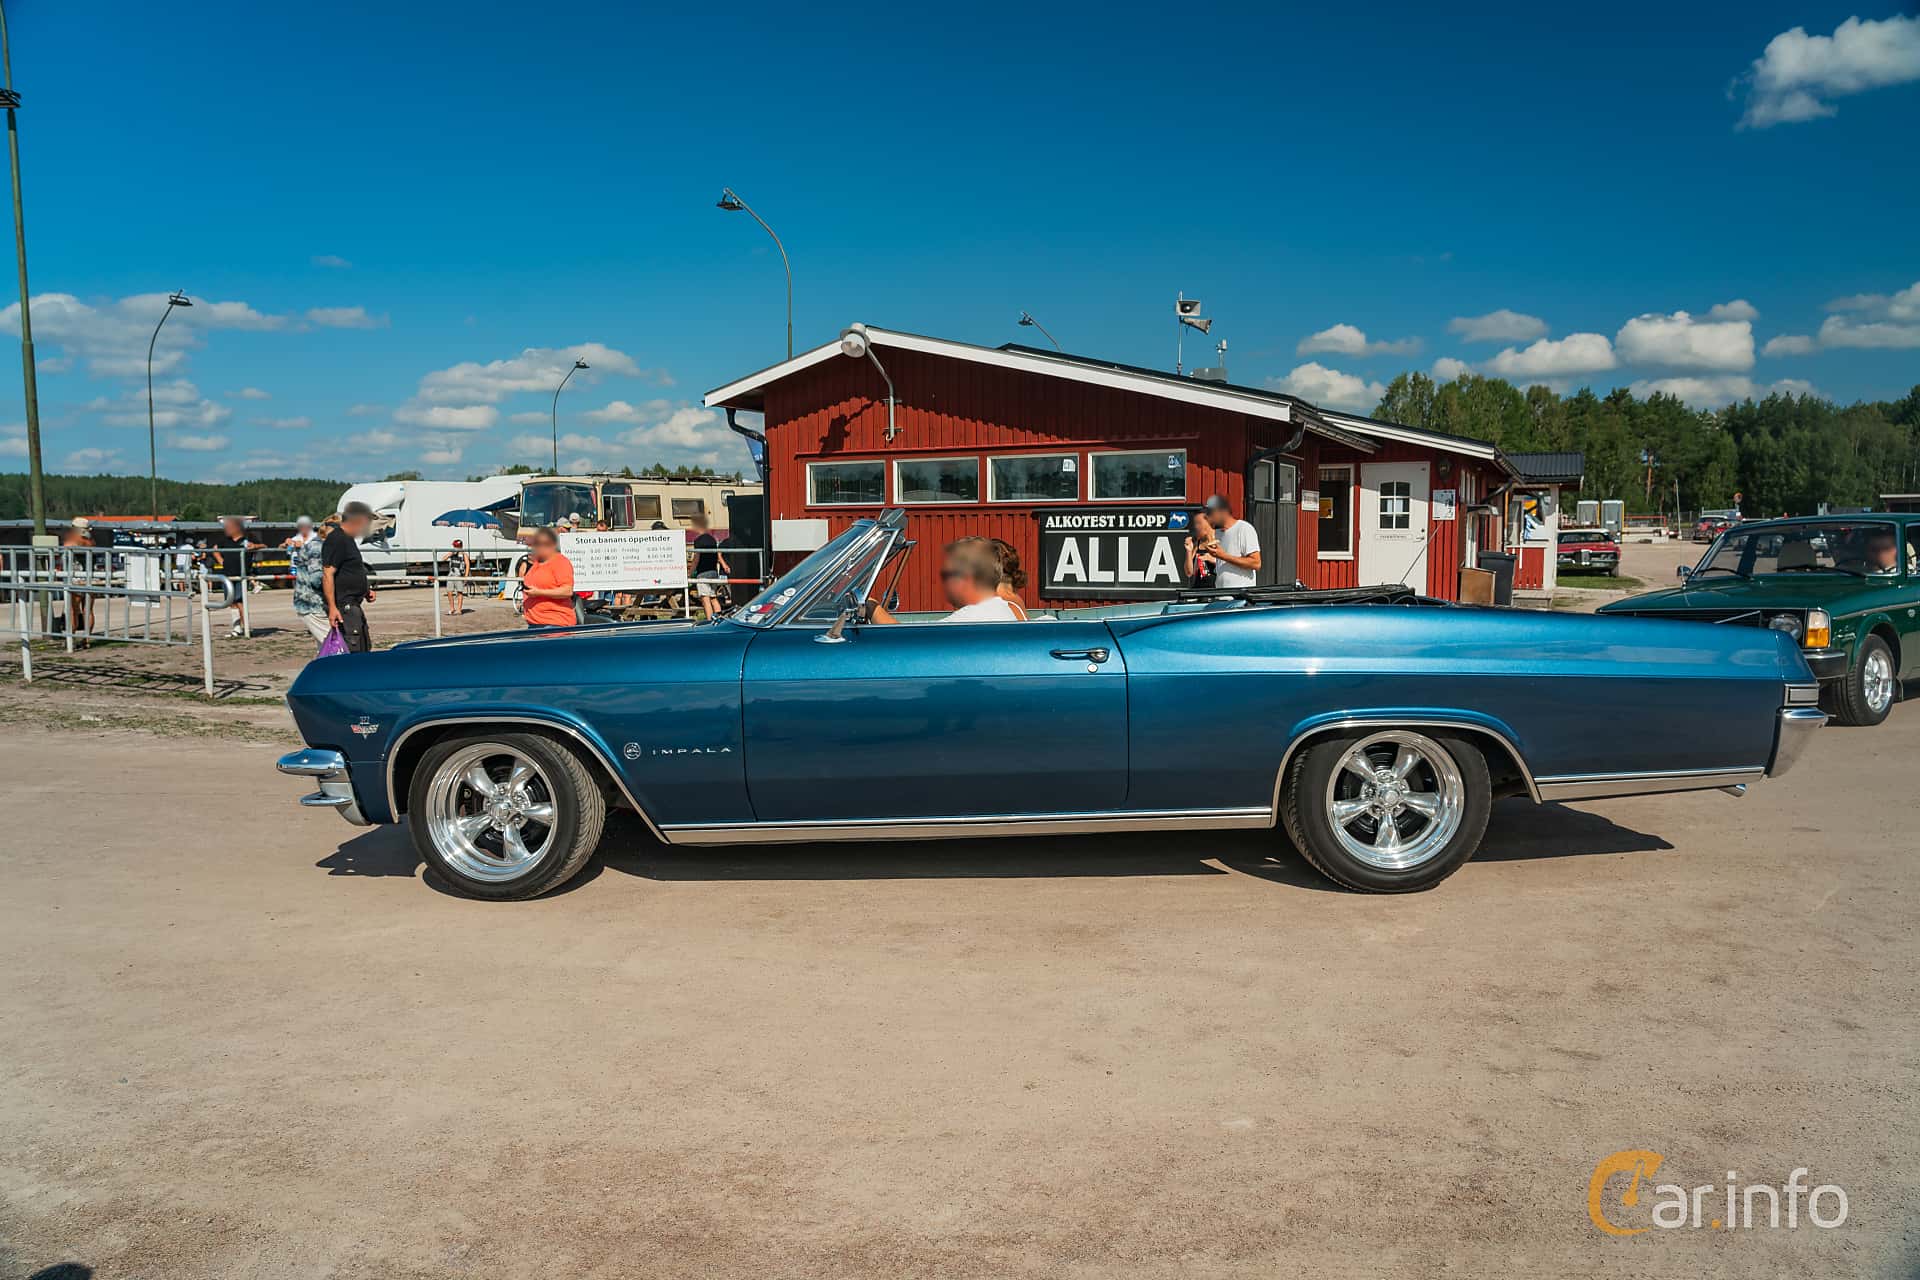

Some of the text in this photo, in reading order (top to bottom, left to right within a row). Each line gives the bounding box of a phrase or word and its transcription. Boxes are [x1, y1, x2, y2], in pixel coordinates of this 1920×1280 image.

[1045, 515, 1167, 528] ALKOTEST I LOPP
[575, 534, 671, 545] Stora banans öppettider
[1053, 536, 1180, 583] ALLA
[652, 747, 732, 756] IMPALA
